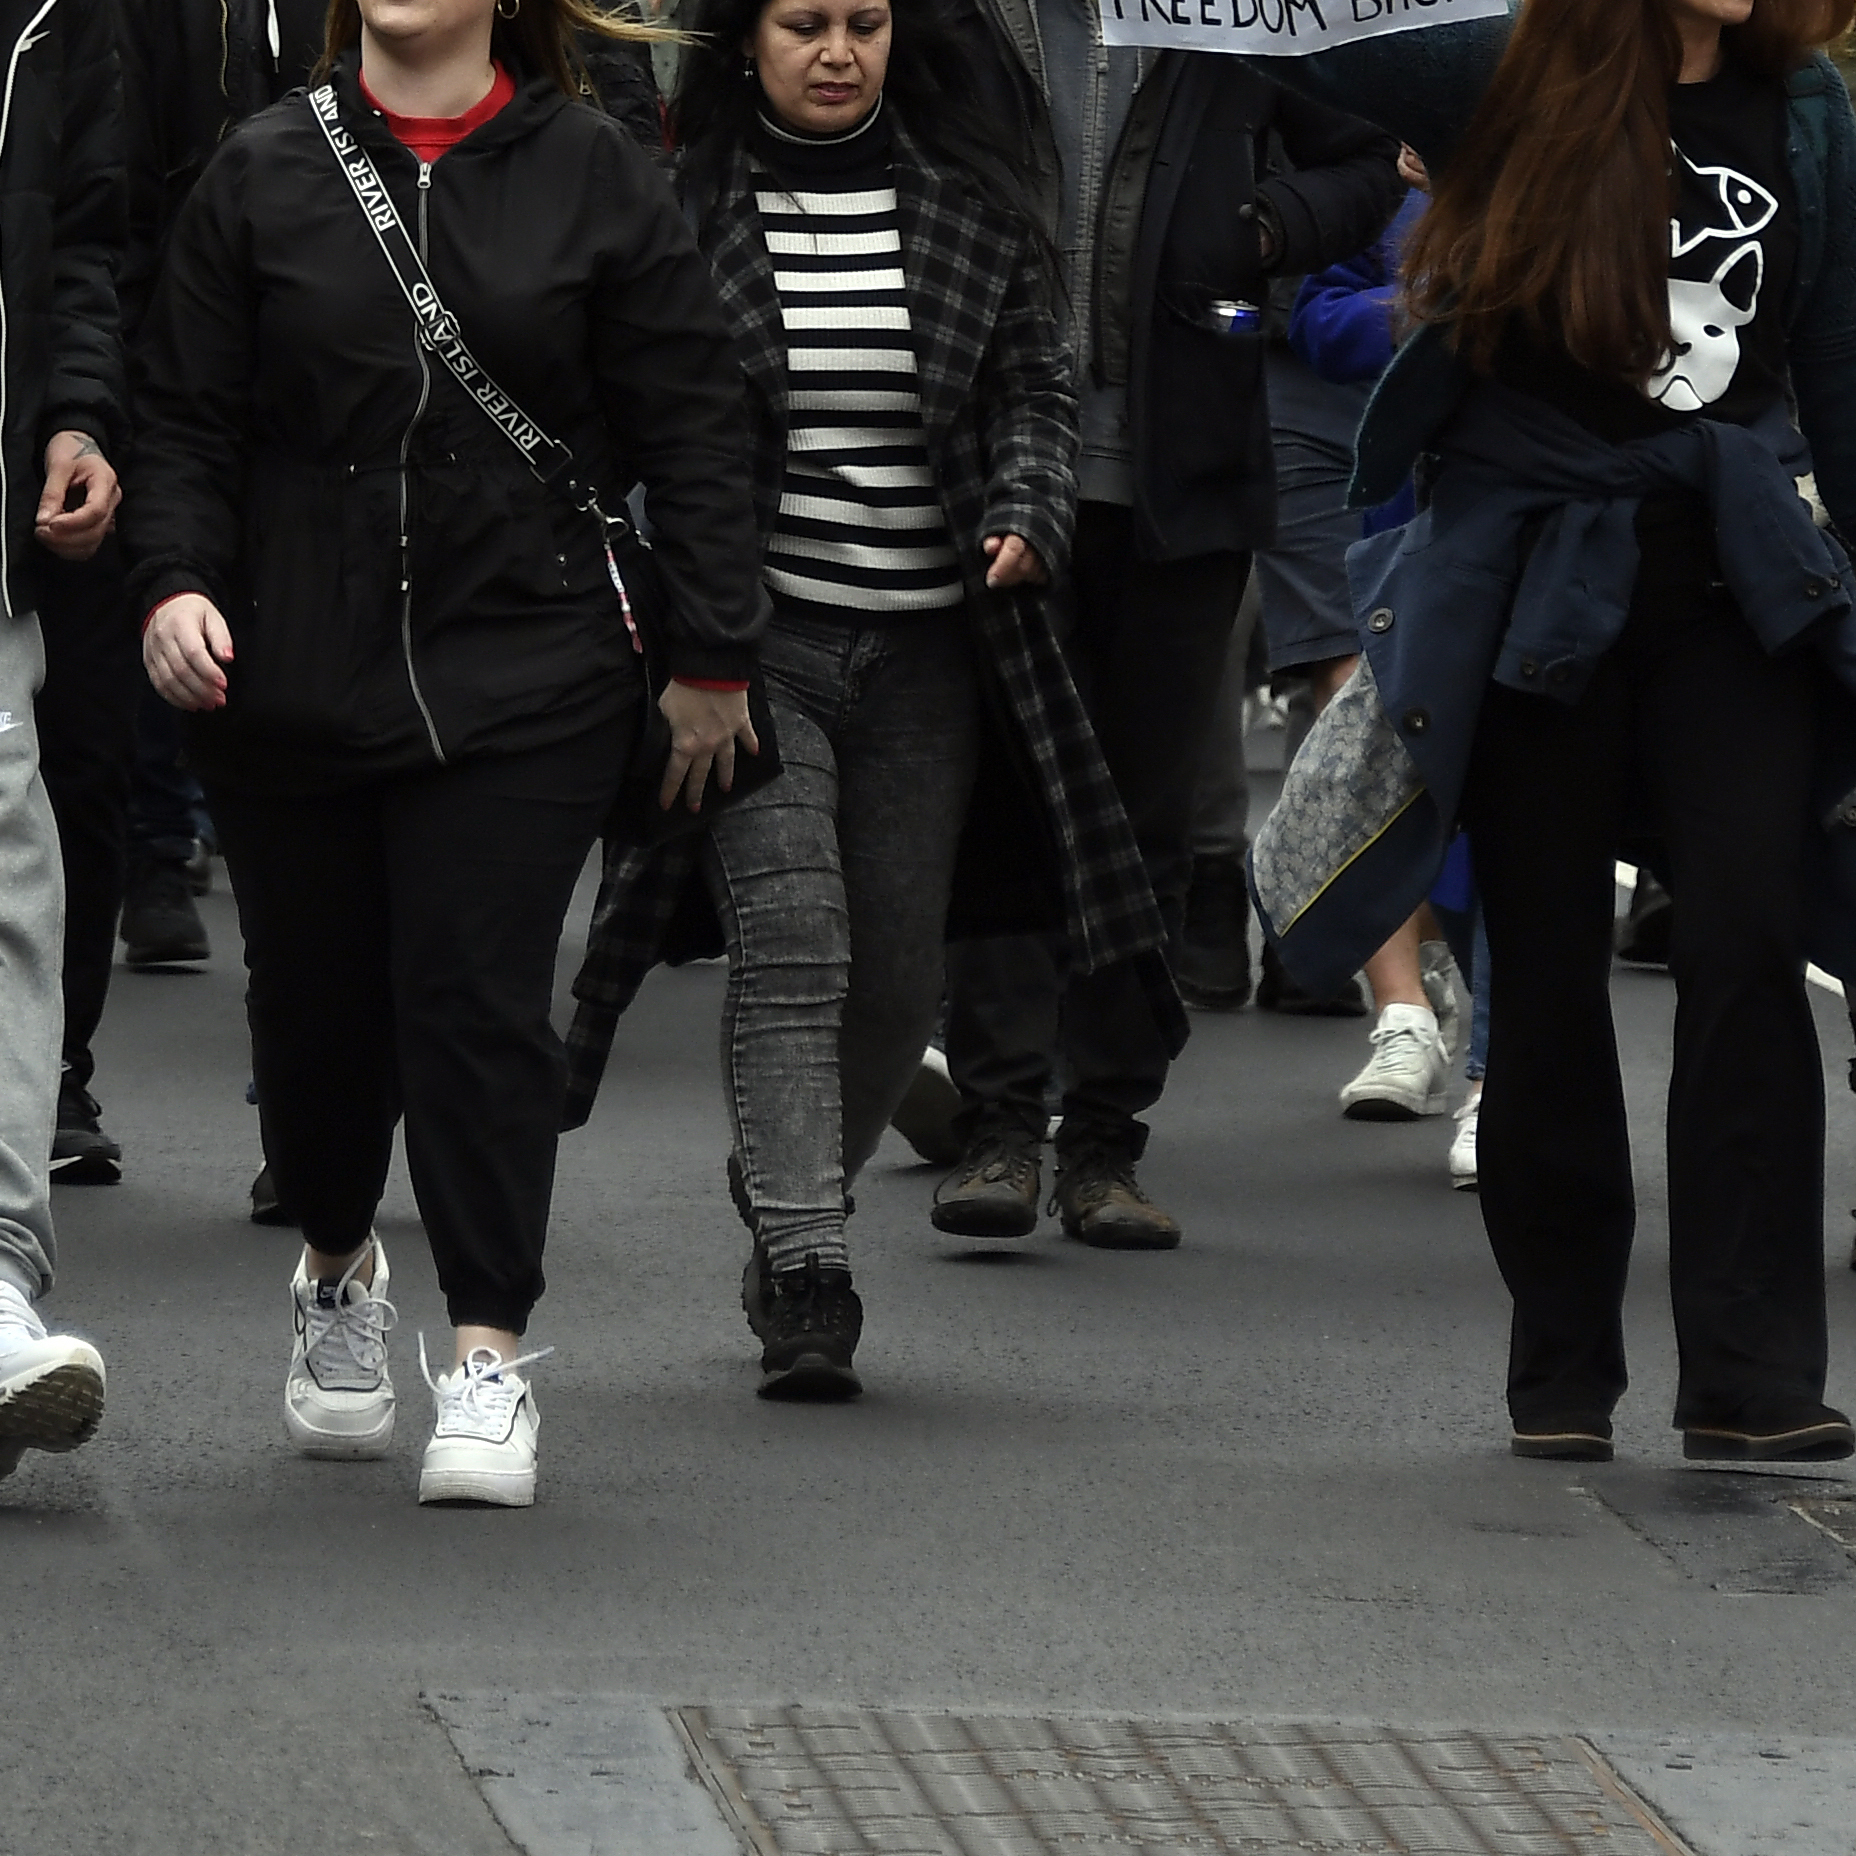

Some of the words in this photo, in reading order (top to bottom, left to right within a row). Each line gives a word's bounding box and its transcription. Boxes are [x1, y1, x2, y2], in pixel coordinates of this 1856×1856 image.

[348, 157, 396, 232] RIVER
[412, 282, 479, 381] ISLAND
[476, 382, 541, 451] RIVER
